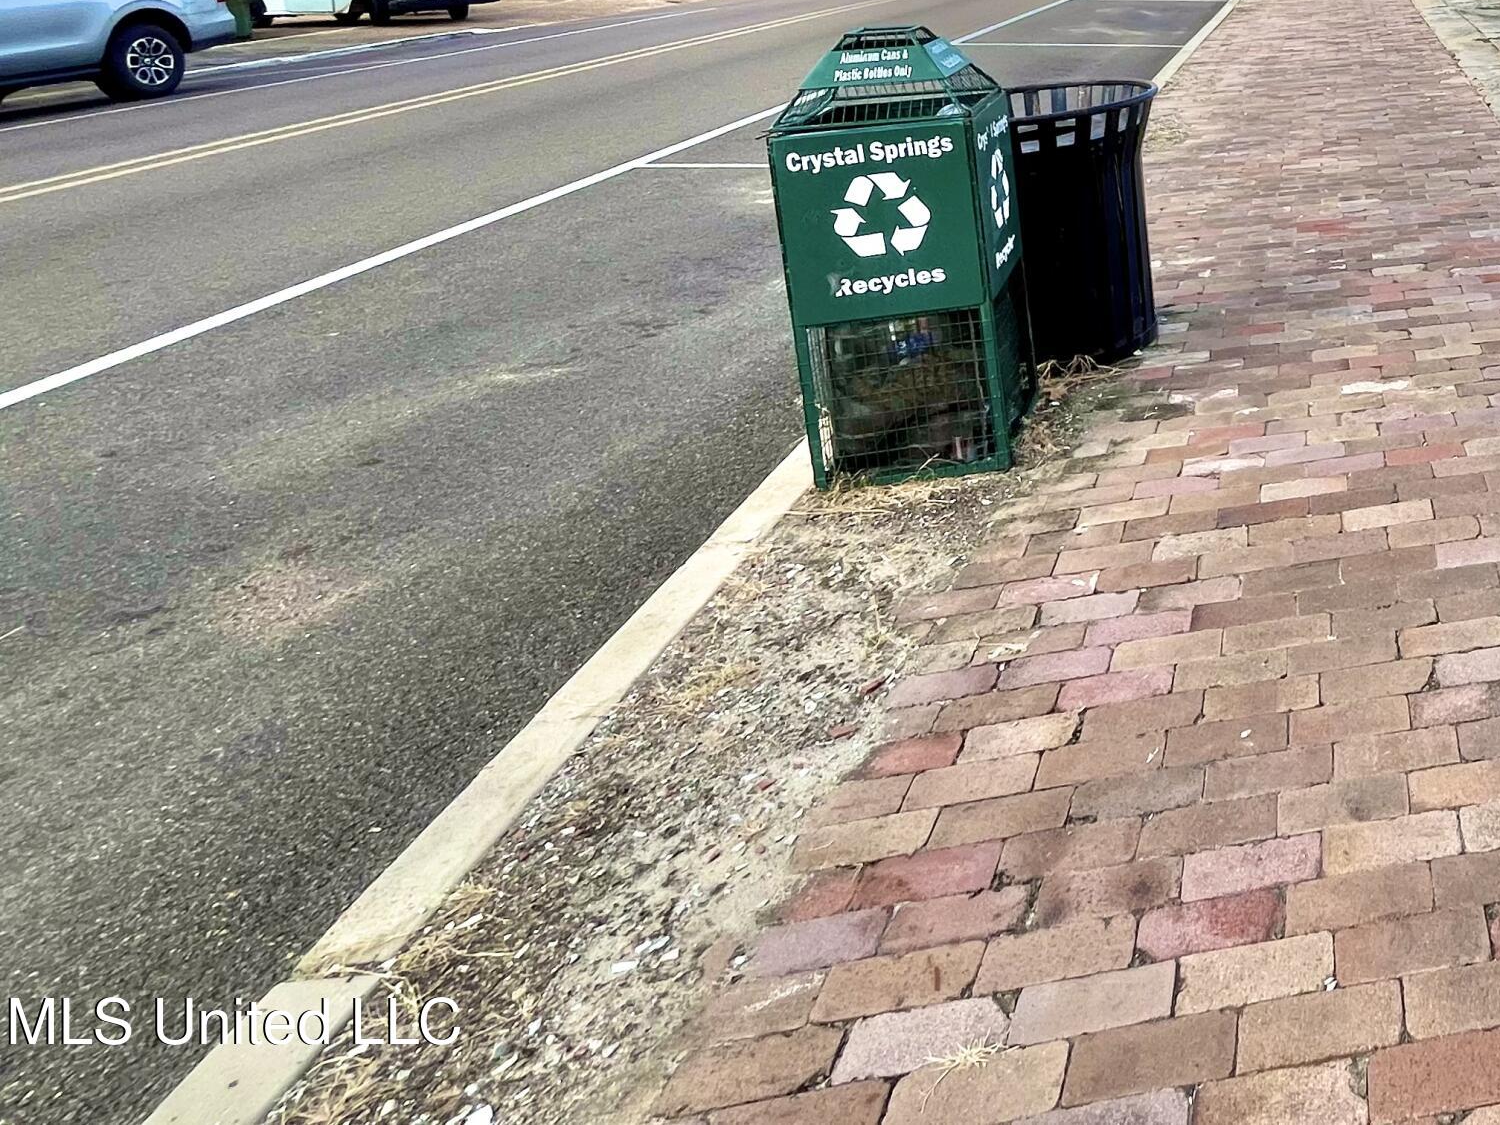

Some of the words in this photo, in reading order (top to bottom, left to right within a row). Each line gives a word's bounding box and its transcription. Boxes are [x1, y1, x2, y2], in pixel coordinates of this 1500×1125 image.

[840, 50, 880, 64] Aluminum
[881, 48, 901, 61] Cans
[834, 68, 862, 82] Plastic
[863, 66, 892, 80] Bottles
[893, 65, 912, 78] Only
[785, 143, 866, 174] Crystal
[869, 135, 954, 164] Springs
